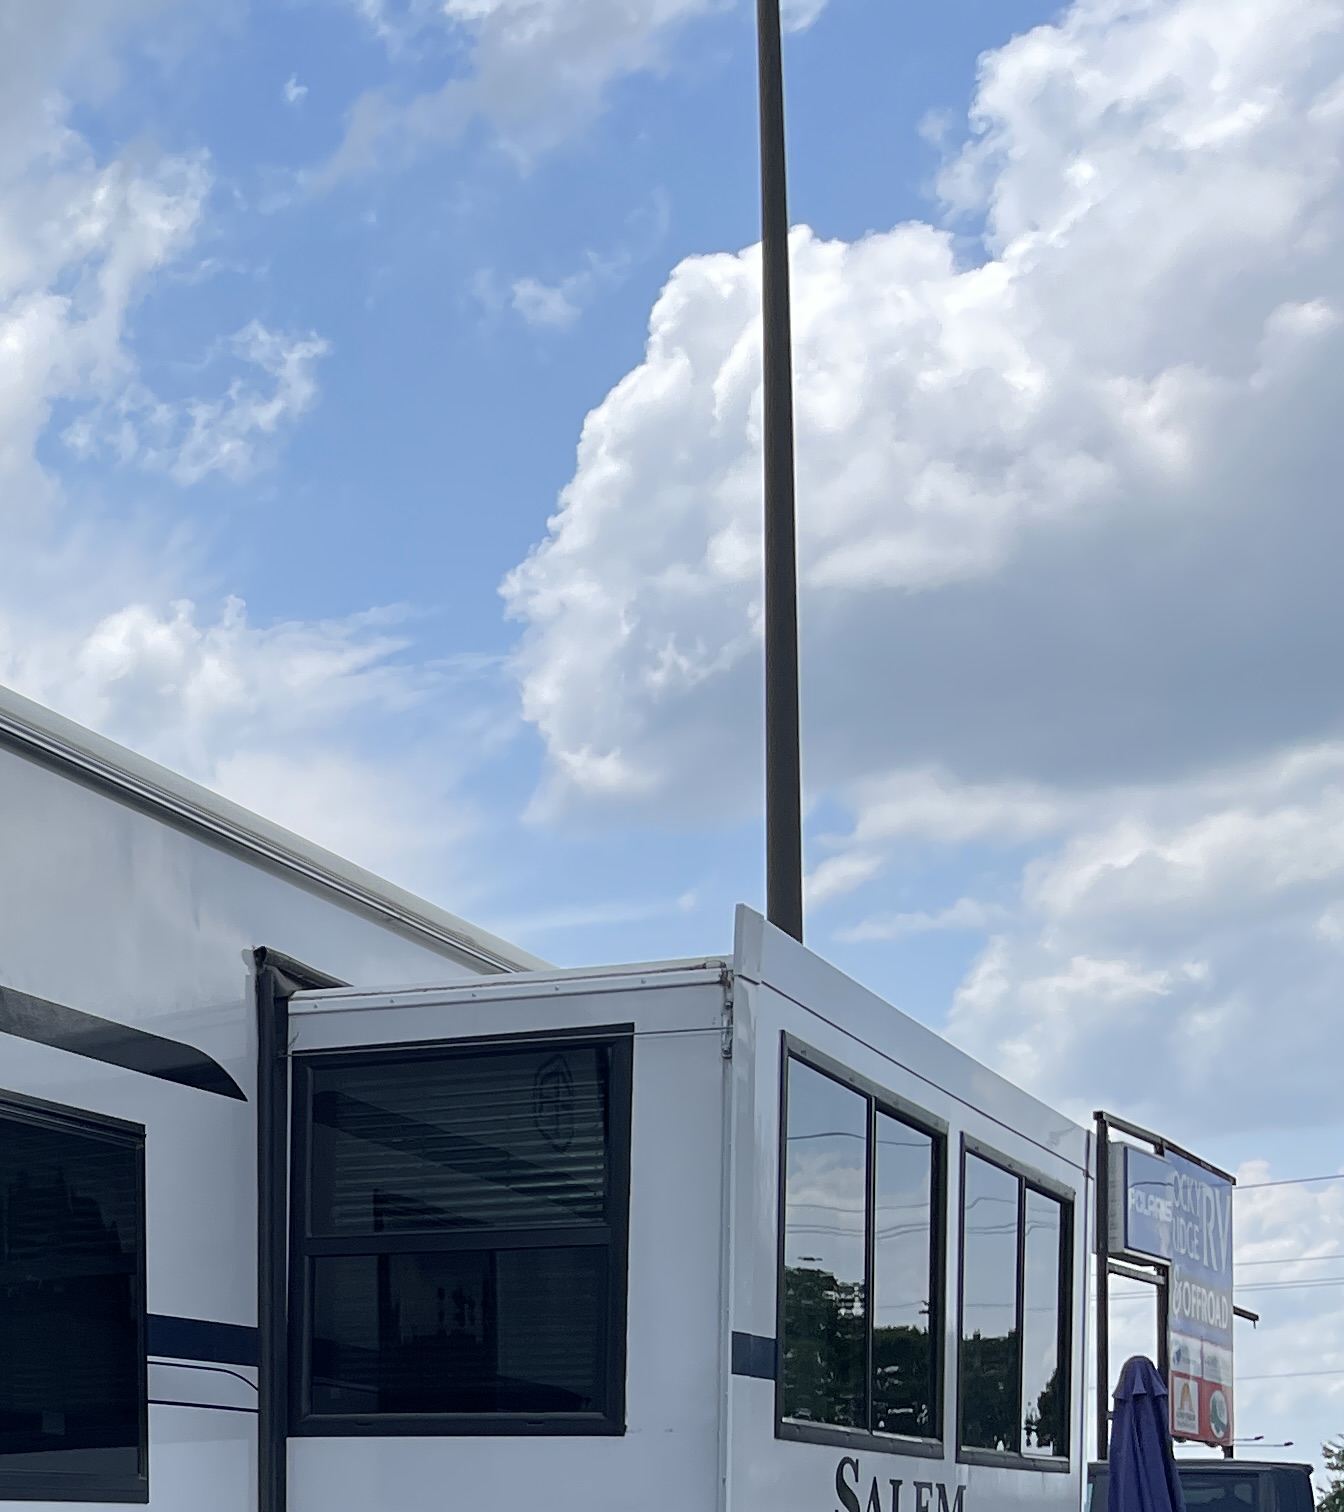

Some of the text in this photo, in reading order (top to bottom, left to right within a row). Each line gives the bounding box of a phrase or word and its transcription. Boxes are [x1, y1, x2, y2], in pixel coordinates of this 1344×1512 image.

[1173, 1170, 1200, 1216] OCKY
[1202, 1183, 1231, 1274] RV
[1182, 1281, 1228, 1329] OFFROAD
